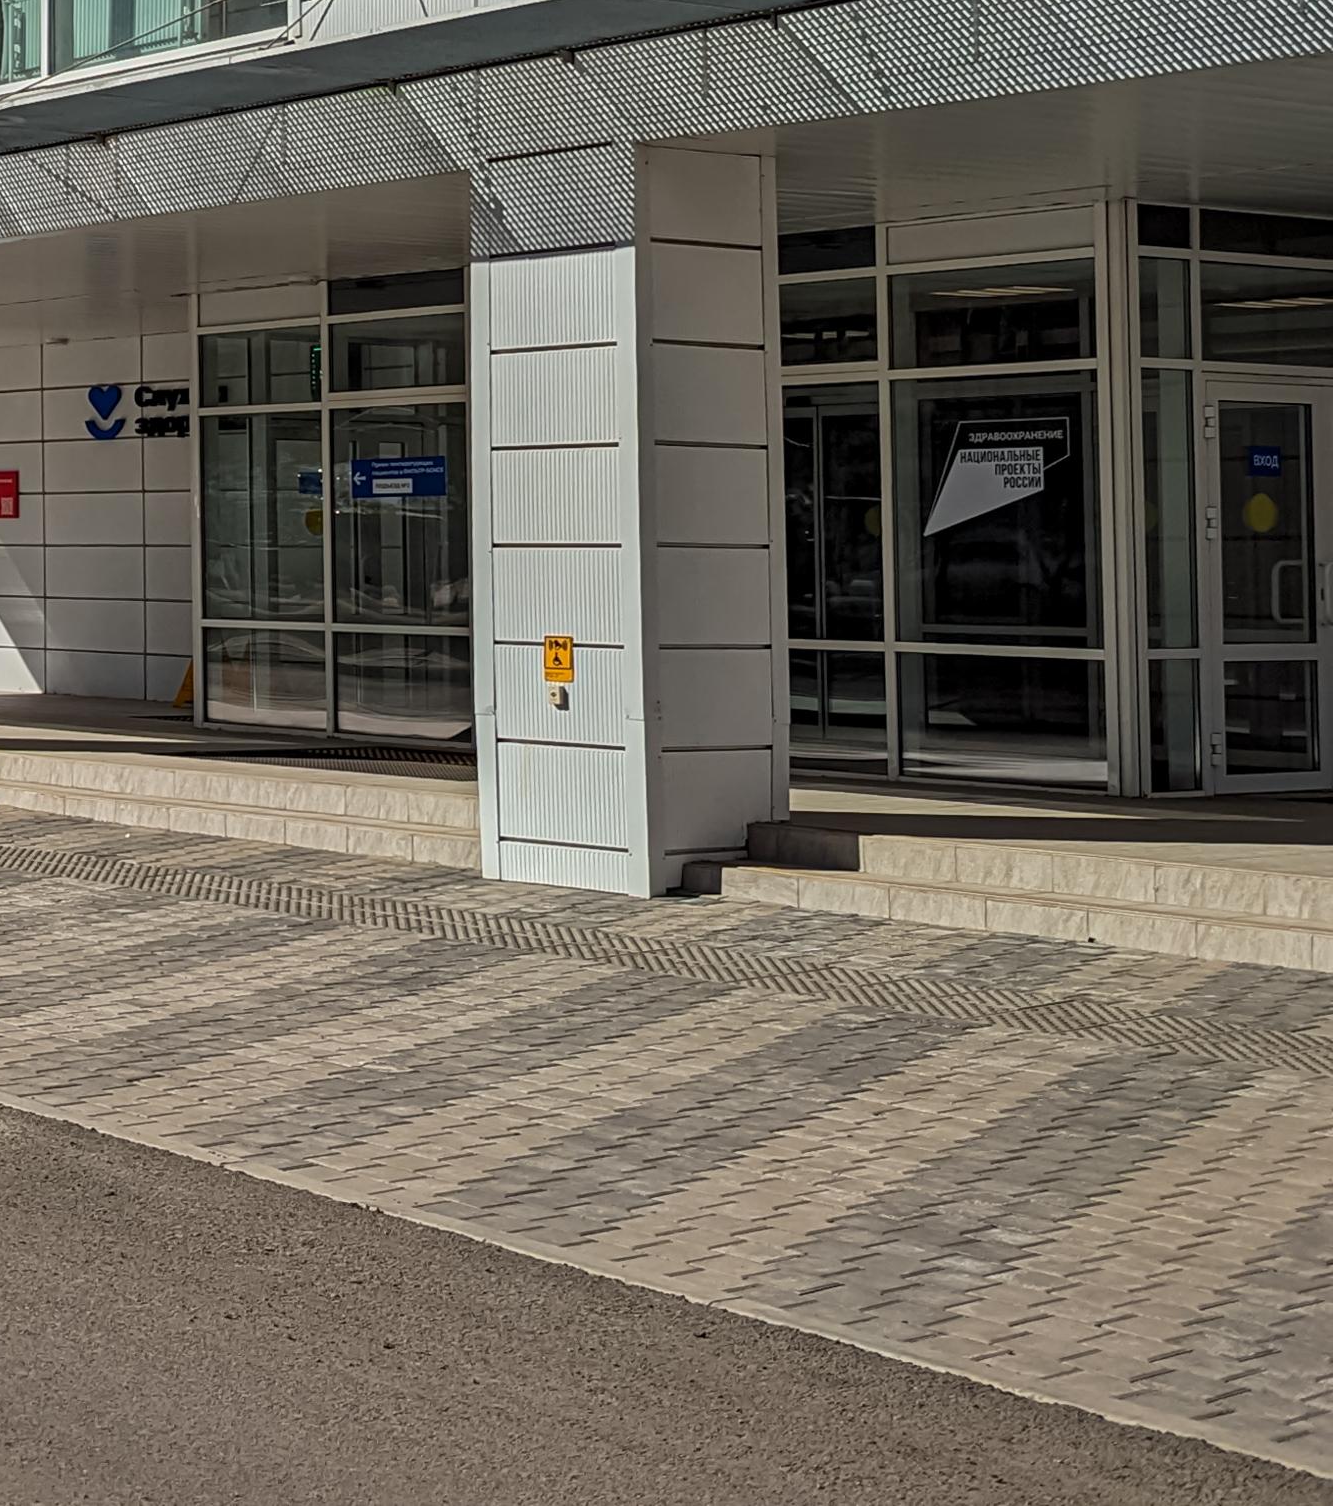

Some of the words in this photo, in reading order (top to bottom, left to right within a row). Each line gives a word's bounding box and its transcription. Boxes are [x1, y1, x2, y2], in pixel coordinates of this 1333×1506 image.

[968, 430, 1065, 444] ЗДРАВООХРАНЕНИЕ
[959, 449, 1041, 464] НАЦИОНАЛЬНЫЕ
[1253, 454, 1279, 469] ВХОД
[994, 463, 1041, 476] ПРОЕКТЫ
[1003, 476, 1042, 489] РОССИИ
